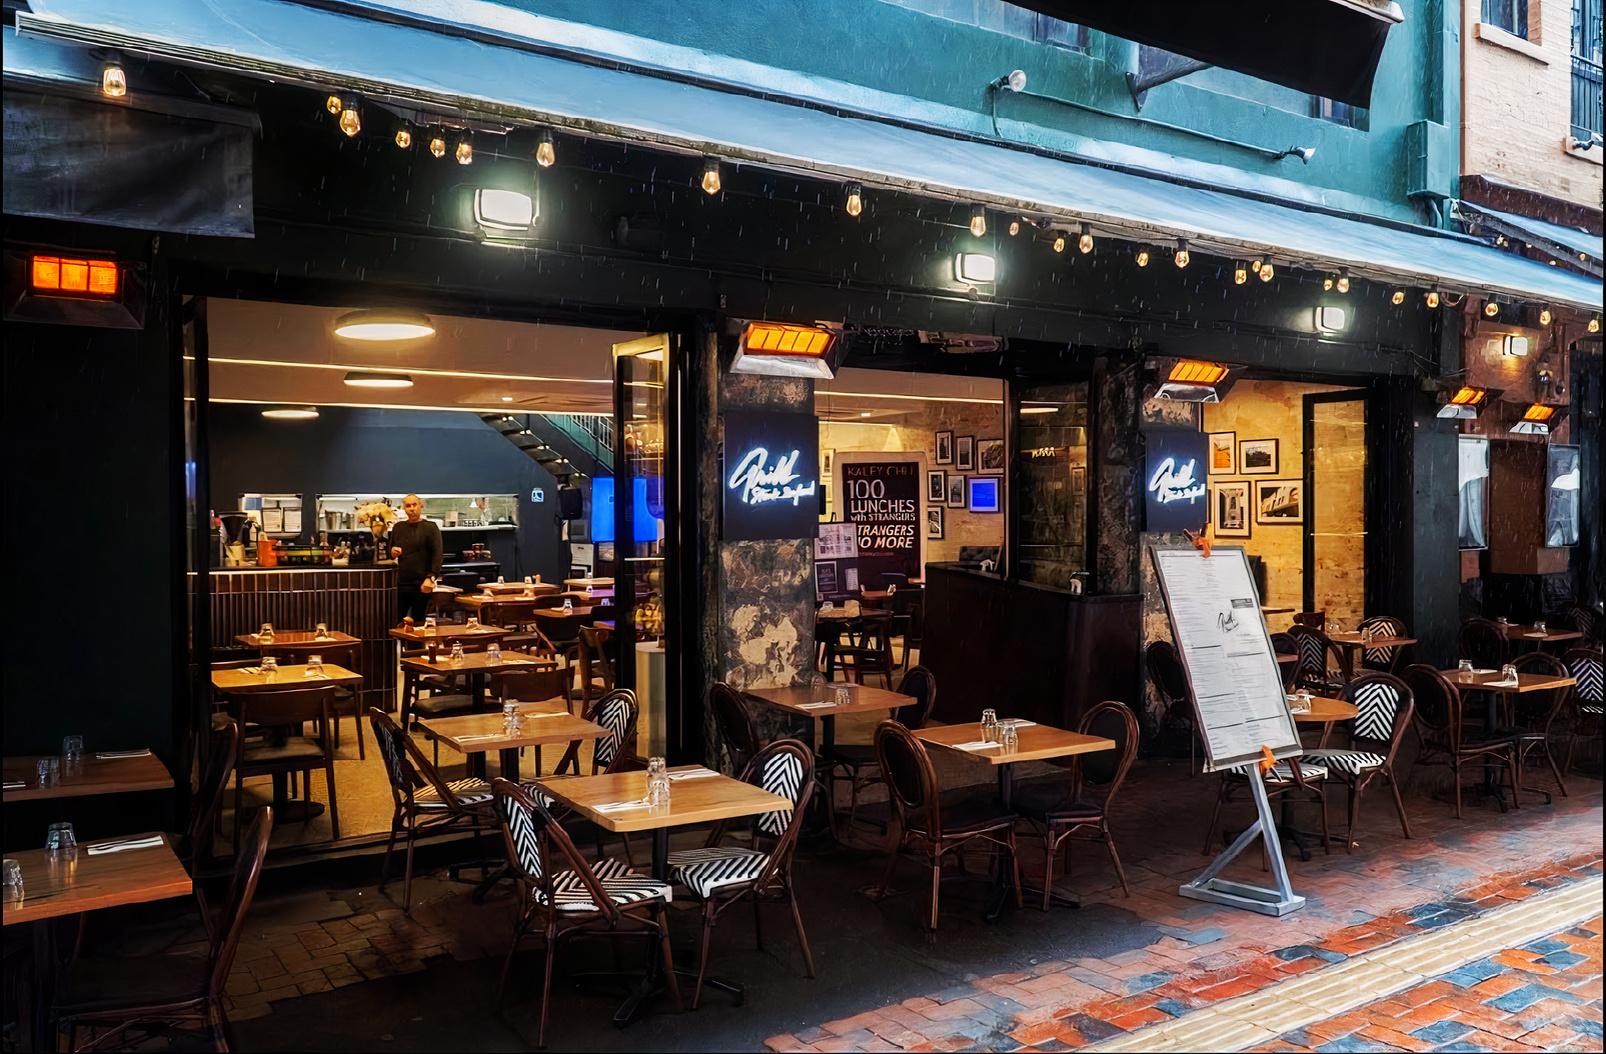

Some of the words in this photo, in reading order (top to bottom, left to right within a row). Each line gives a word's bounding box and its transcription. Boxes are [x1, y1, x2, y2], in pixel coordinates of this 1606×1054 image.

[847, 479, 885, 499] 100
[850, 499, 915, 513] LUNCHES
[850, 512, 867, 522] with
[868, 512, 916, 522] STRANGERS
[857, 524, 915, 536] TRANGERS
[874, 536, 915, 549] MORE
